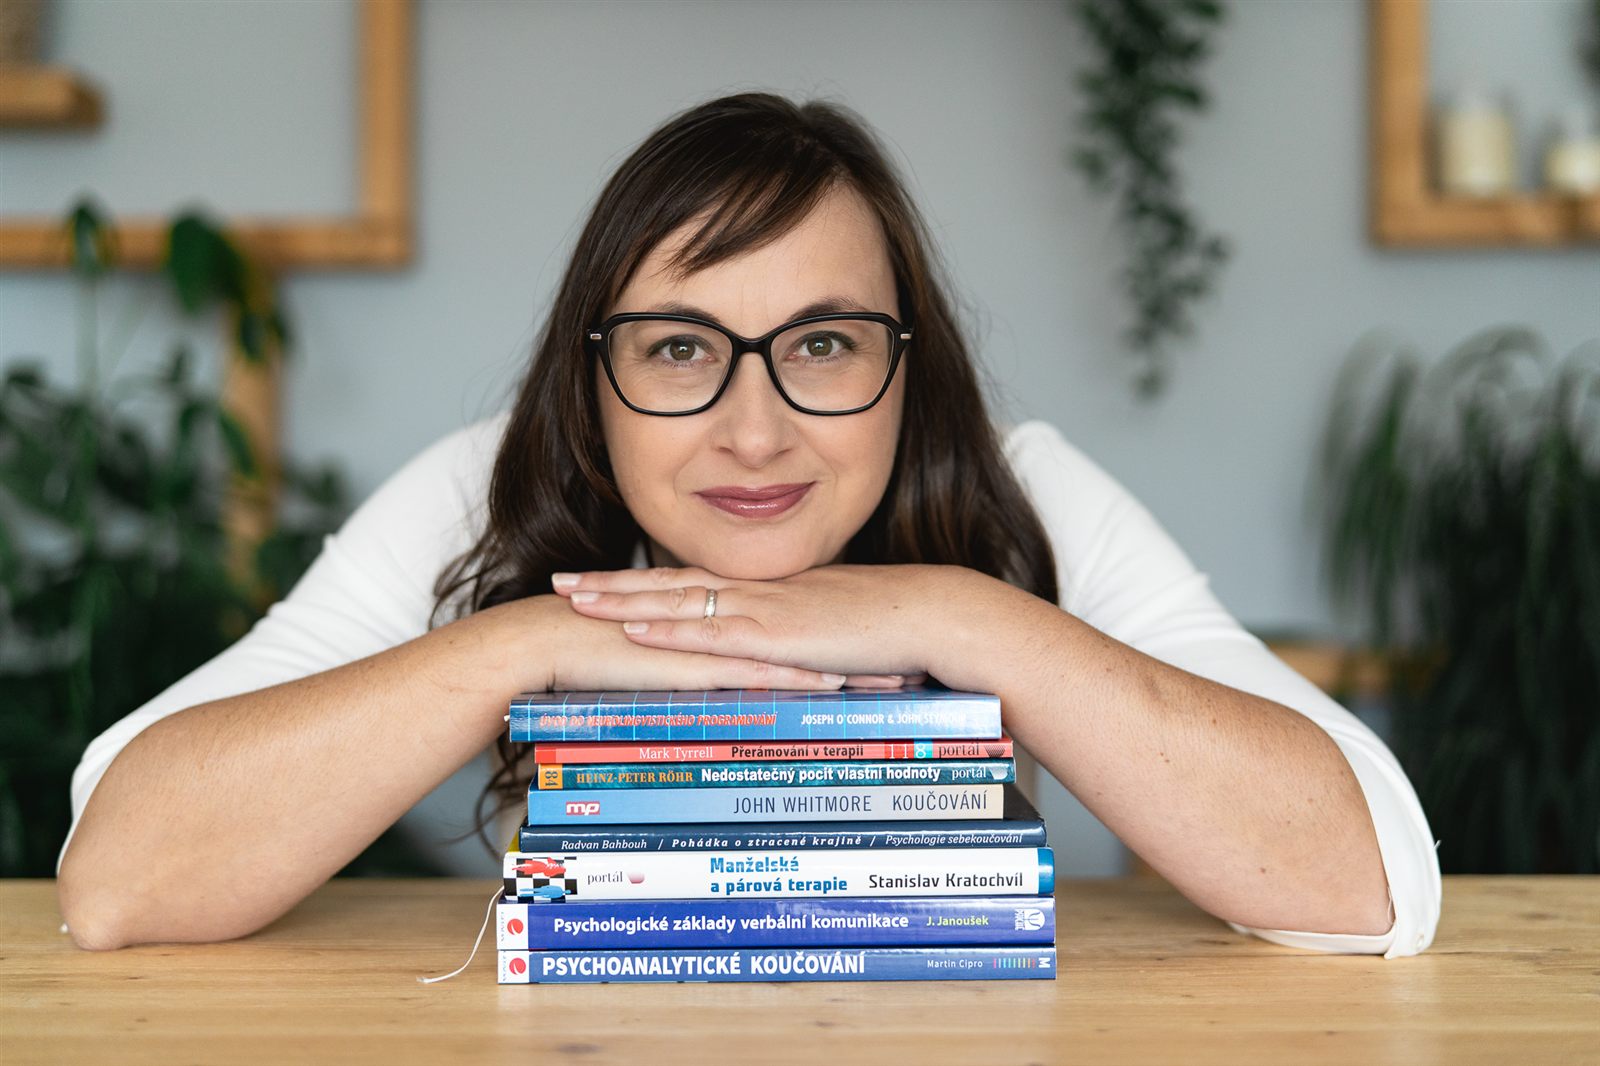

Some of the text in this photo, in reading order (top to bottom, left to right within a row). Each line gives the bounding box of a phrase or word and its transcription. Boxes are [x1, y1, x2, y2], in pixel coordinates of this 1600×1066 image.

[587, 711, 695, 726] NEUROLINGVISTICKÉHO
[697, 711, 778, 726] PROGRAMOVÁNÍ
[801, 714, 833, 725] JOSEPH
[887, 714, 894, 724] &
[897, 713, 921, 724] JOHN
[639, 747, 713, 762] Mark Tyrrell
[731, 745, 864, 760] Přerámování v terapii
[938, 739, 979, 758] portál
[576, 769, 693, 783] HEINZ-PETER RÖHR
[701, 766, 941, 785] Nedostatečný pocit vlastní hodnoty
[952, 766, 986, 781] portál
[733, 795, 872, 814] JOHN WHITMORE
[893, 790, 988, 811] KOUČOVÁNÍ
[561, 840, 599, 850] Radvan
[602, 839, 647, 849] Bahbouh
[672, 838, 728, 848] Pohádka
[748, 837, 806, 847] ztracené
[812, 836, 862, 847] krajině
[886, 834, 947, 847] Psychologie
[948, 833, 1023, 844] sebekoučování
[710, 856, 799, 874] Manželské
[587, 872, 623, 885] portál
[711, 877, 848, 895] a párová terapie
[869, 873, 1023, 889] Stanislav Kratochvíl
[554, 912, 909, 935] Psychologické základy verbální komunikace
[926, 914, 989, 927] J. Janoušek
[542, 951, 865, 976] PSYCHOANALYTICKÉ KOUČOVÁNÍ
[927, 959, 983, 970] Martin Cipro
